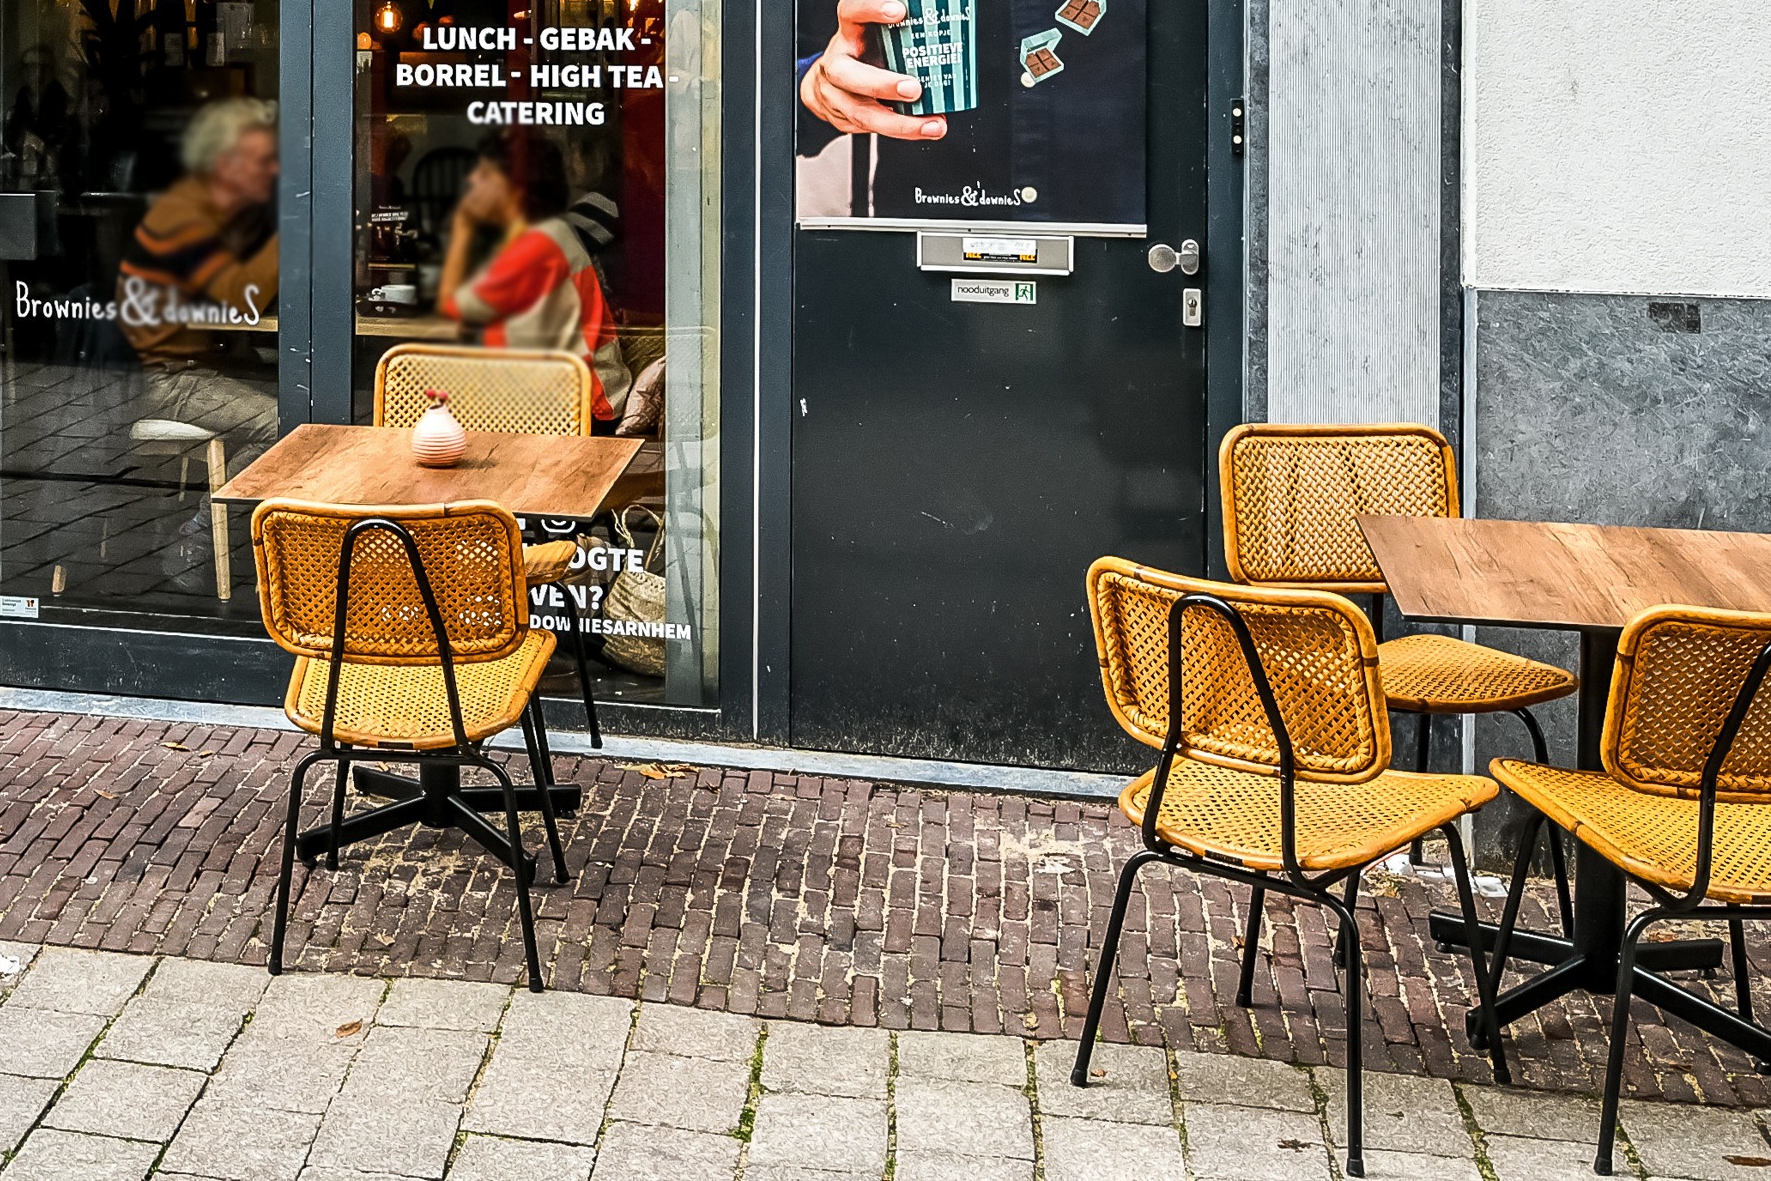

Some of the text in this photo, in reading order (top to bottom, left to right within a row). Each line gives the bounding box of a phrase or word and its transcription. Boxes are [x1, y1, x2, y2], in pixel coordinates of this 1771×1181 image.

[423, 27, 516, 50] LUNCH
[540, 27, 635, 51] GEBAK
[396, 64, 506, 87] BORREL
[530, 65, 601, 87] HIGH
[608, 65, 664, 88] TEA
[467, 101, 605, 125] CATERING
[915, 187, 959, 204] Brownies
[16, 280, 117, 319] Brownies
[121, 276, 162, 326] &
[957, 285, 1010, 297] nooduitgang
